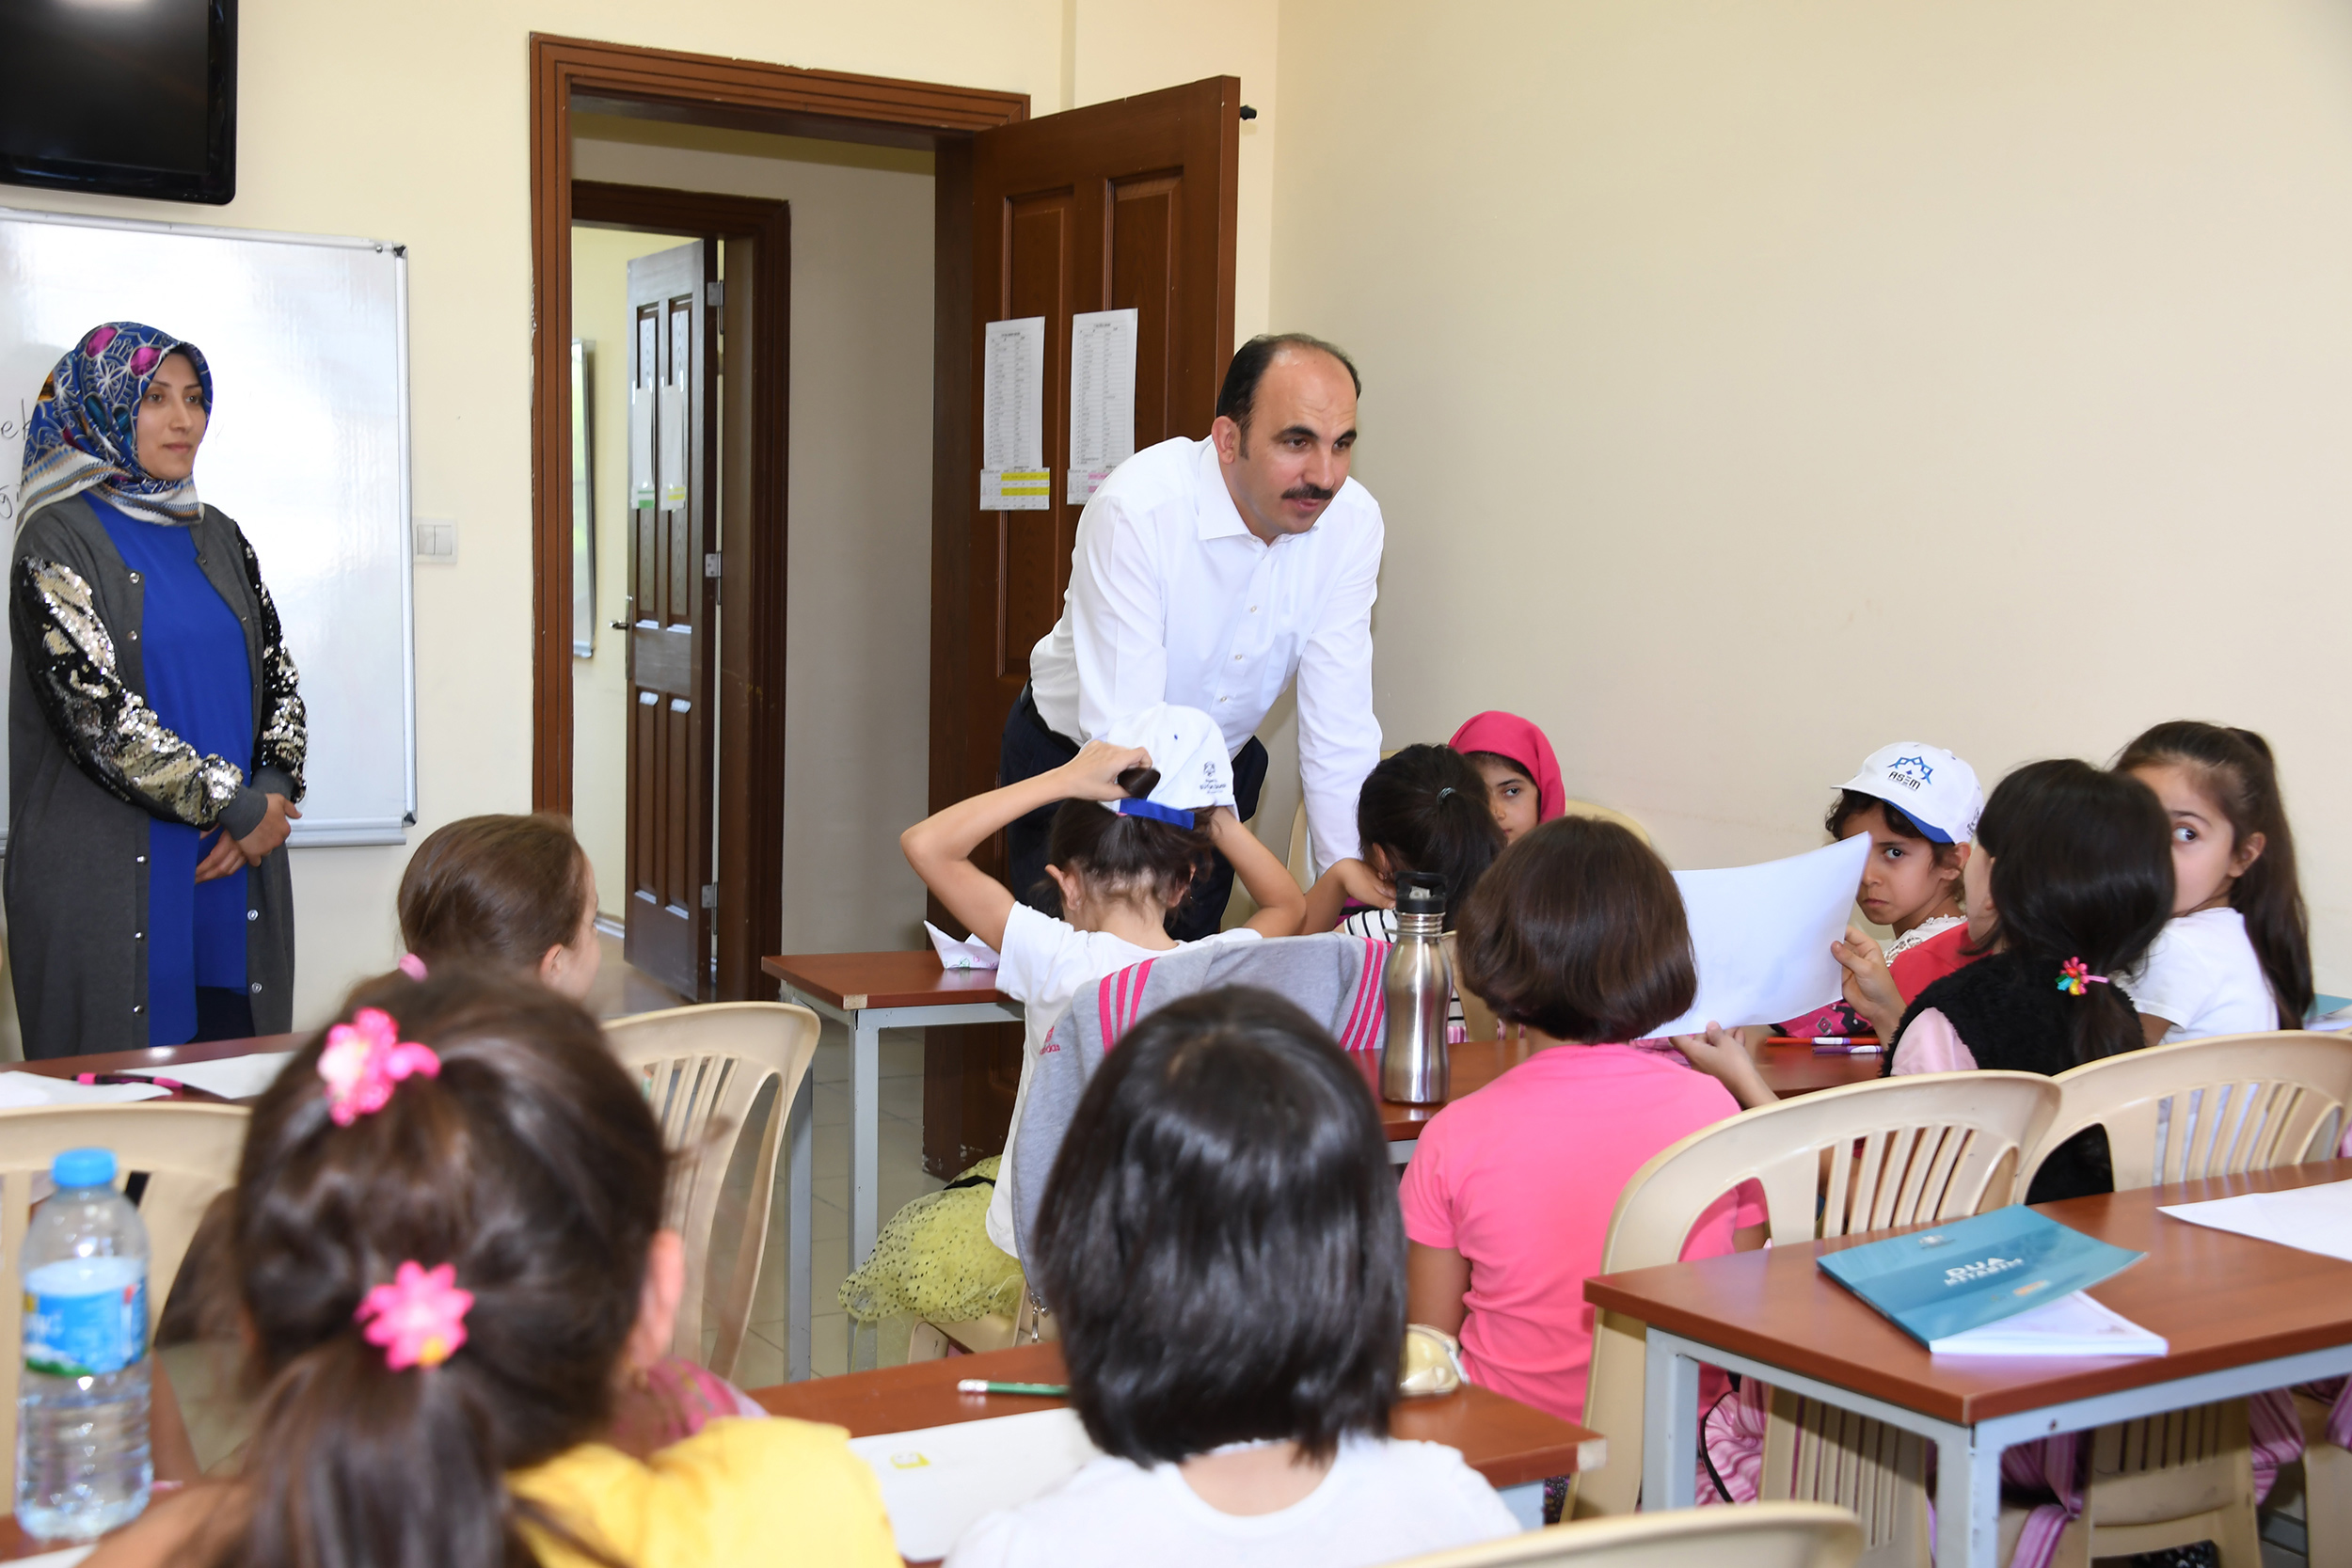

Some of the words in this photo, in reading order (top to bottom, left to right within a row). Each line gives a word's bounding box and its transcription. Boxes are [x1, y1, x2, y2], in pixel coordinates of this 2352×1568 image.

[1888, 770, 1921, 790] ASEM
[1040, 1043, 1061, 1054] didas
[1945, 1257, 2006, 1277] DUA
